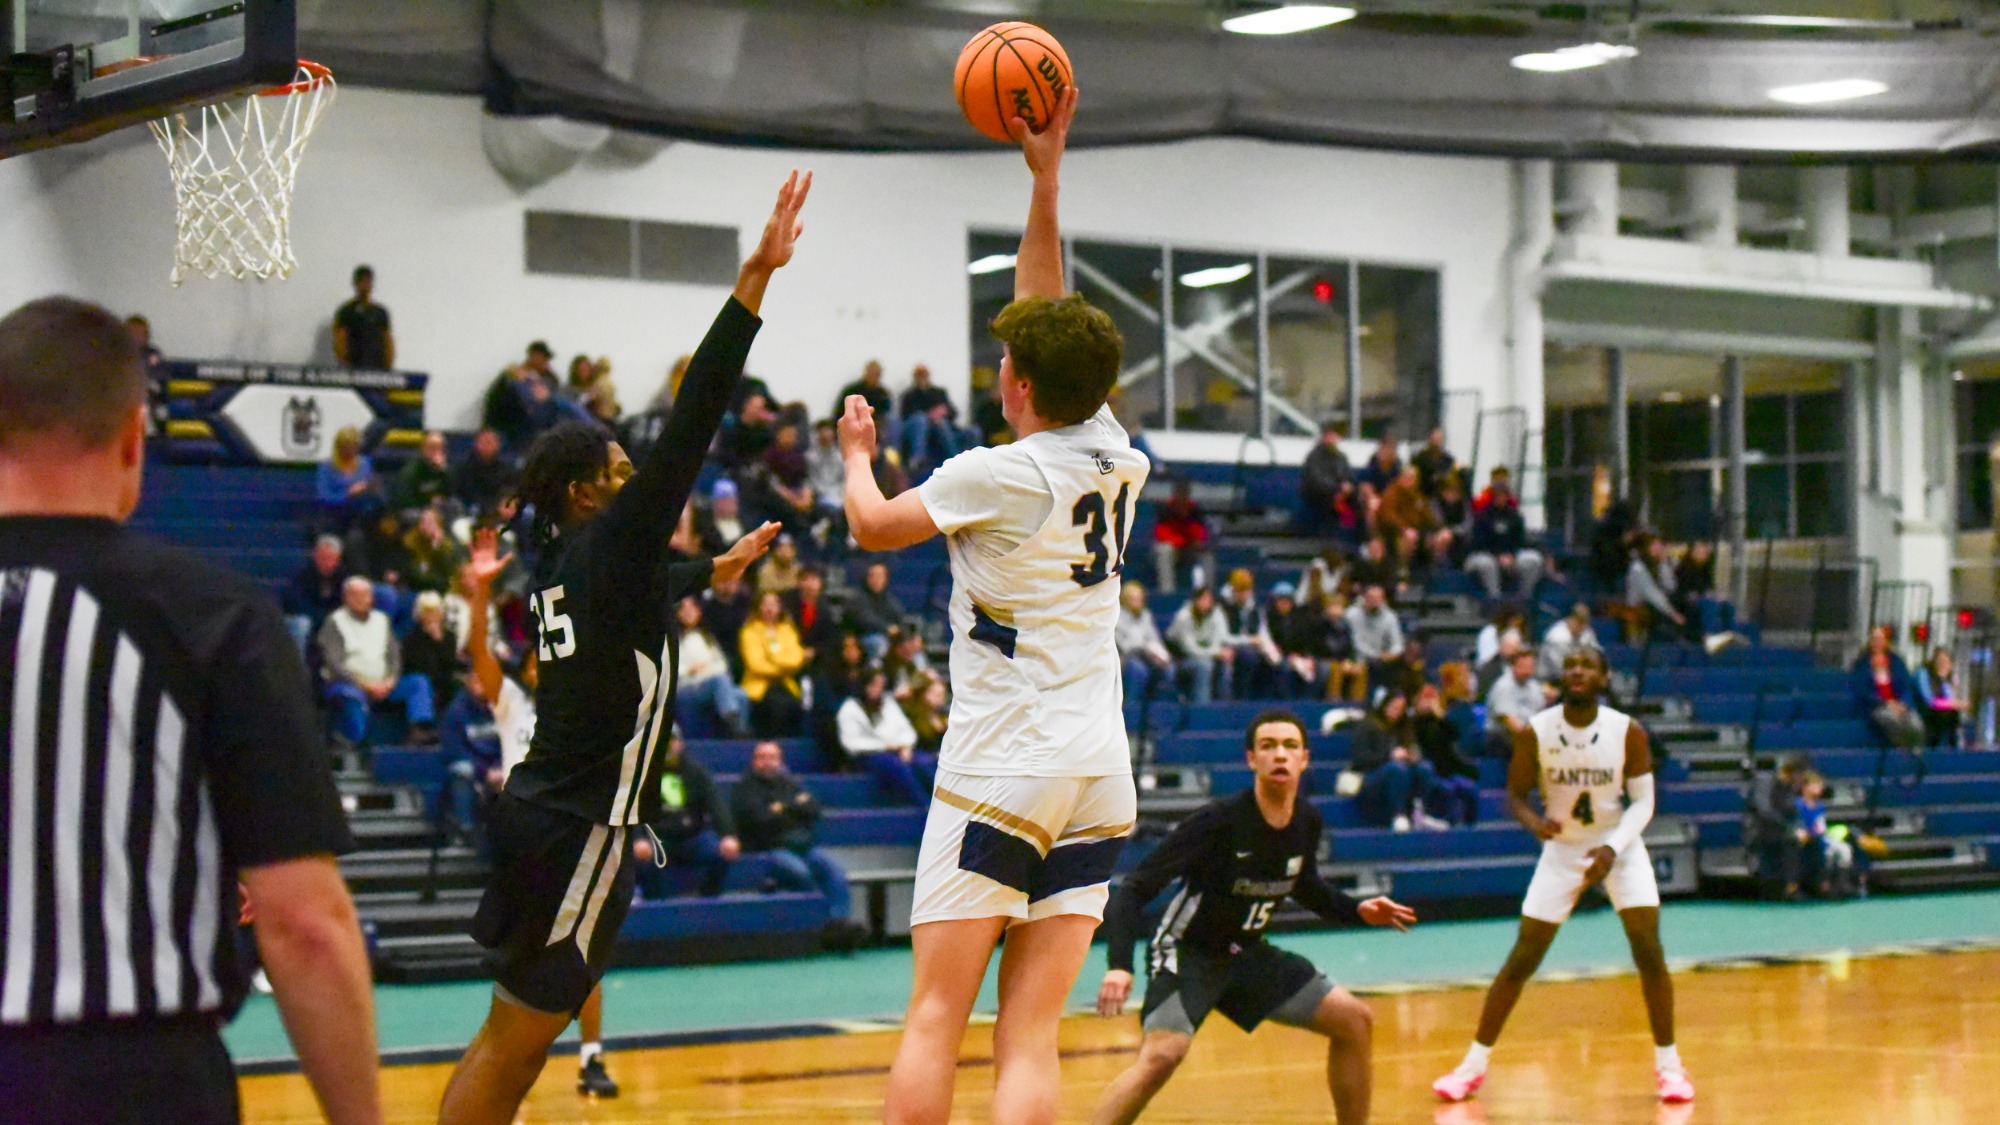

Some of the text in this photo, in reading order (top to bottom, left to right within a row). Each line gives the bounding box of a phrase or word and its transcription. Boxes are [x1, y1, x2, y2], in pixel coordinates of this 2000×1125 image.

[1070, 482, 1130, 588] 31
[1546, 767, 1614, 787] CANTON
[1571, 791, 1595, 826] 4
[1242, 901, 1276, 930] 15
